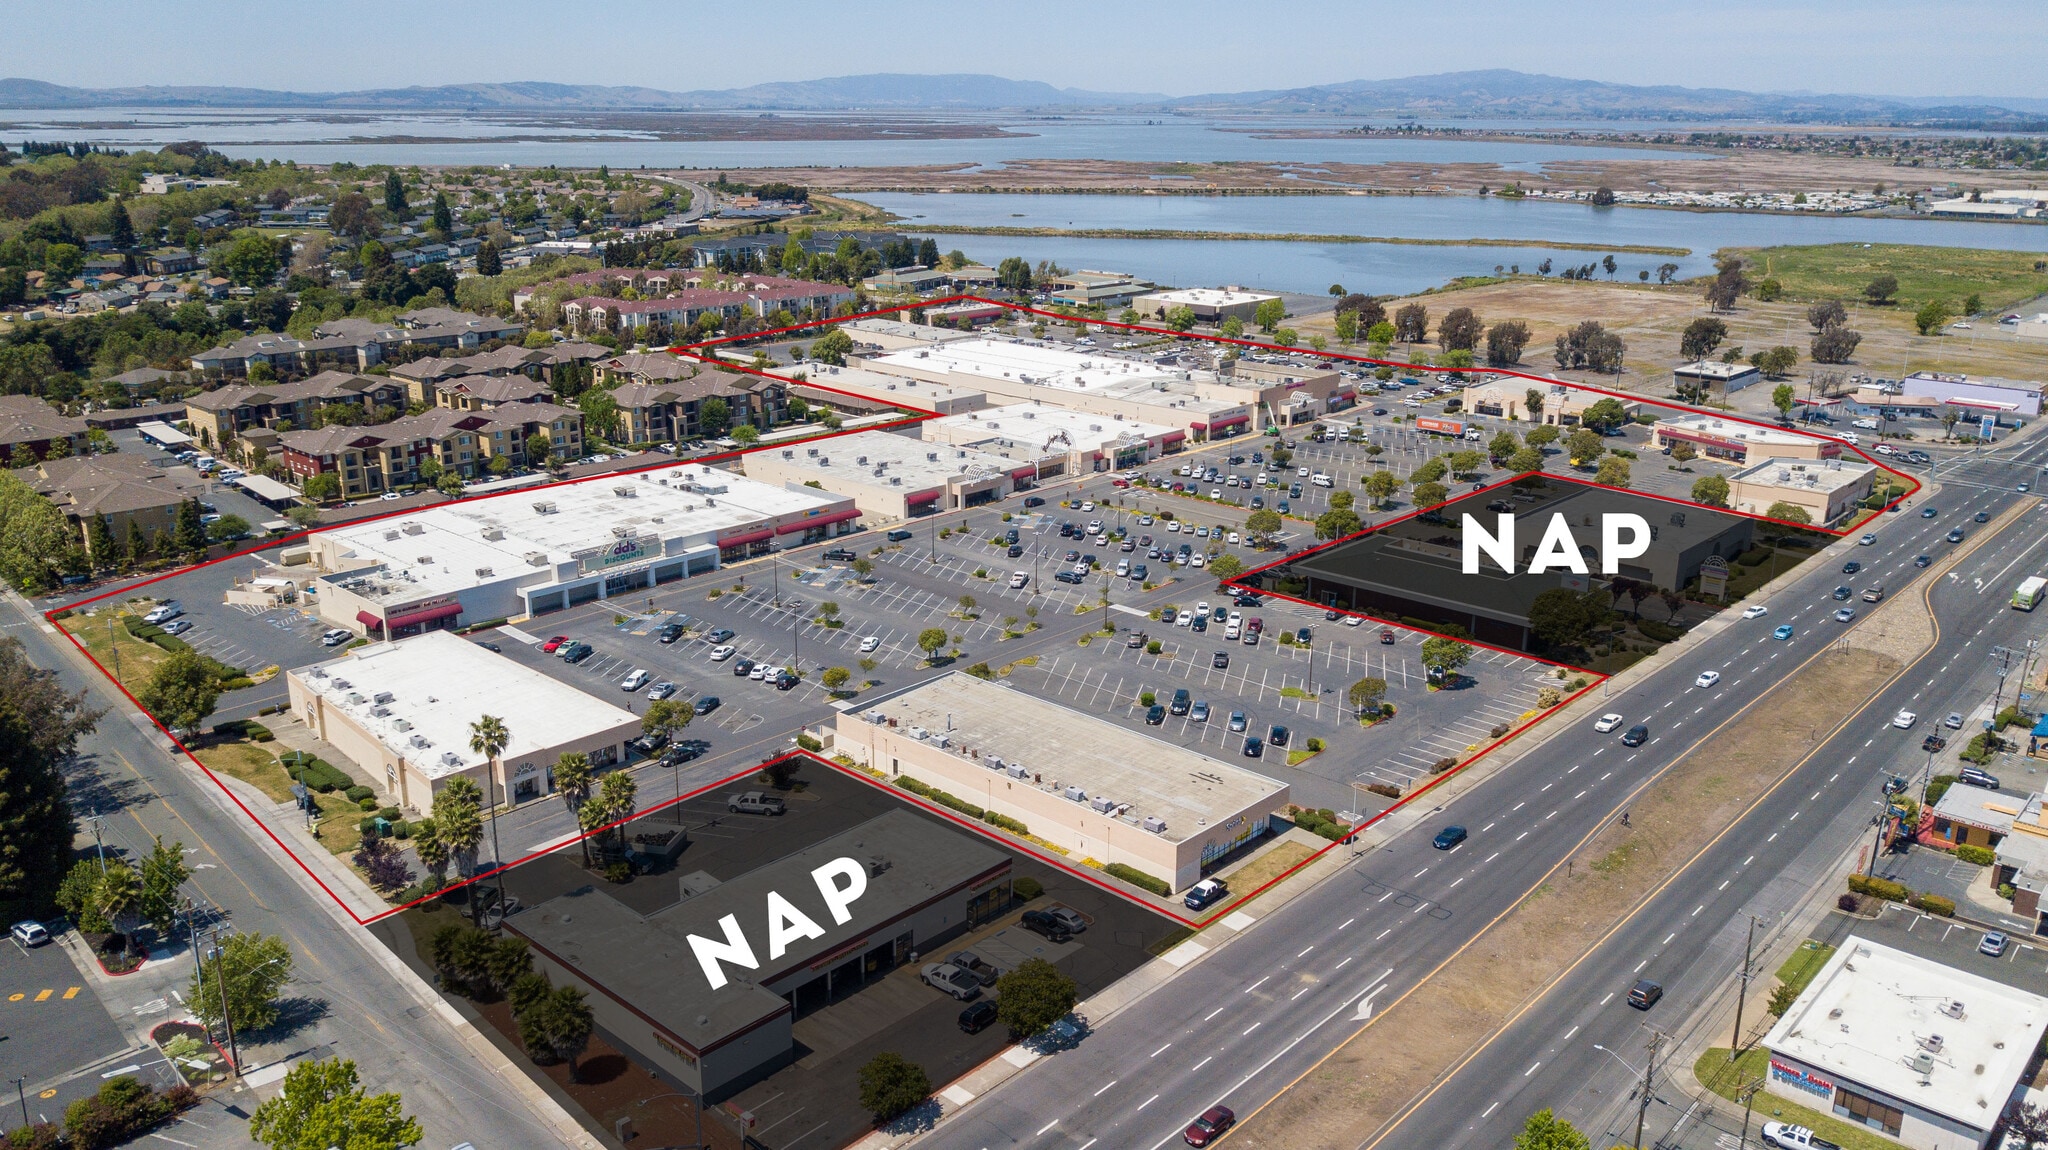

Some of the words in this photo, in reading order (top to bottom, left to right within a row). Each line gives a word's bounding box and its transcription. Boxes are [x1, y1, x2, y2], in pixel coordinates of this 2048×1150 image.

[613, 540, 637, 555] dd's
[604, 549, 645, 565] DISCOUNTS
[1937, 813, 1965, 823] Tacos
[1971, 822, 2007, 834] Jalisco
[1807, 1073, 1834, 1090] Dental
